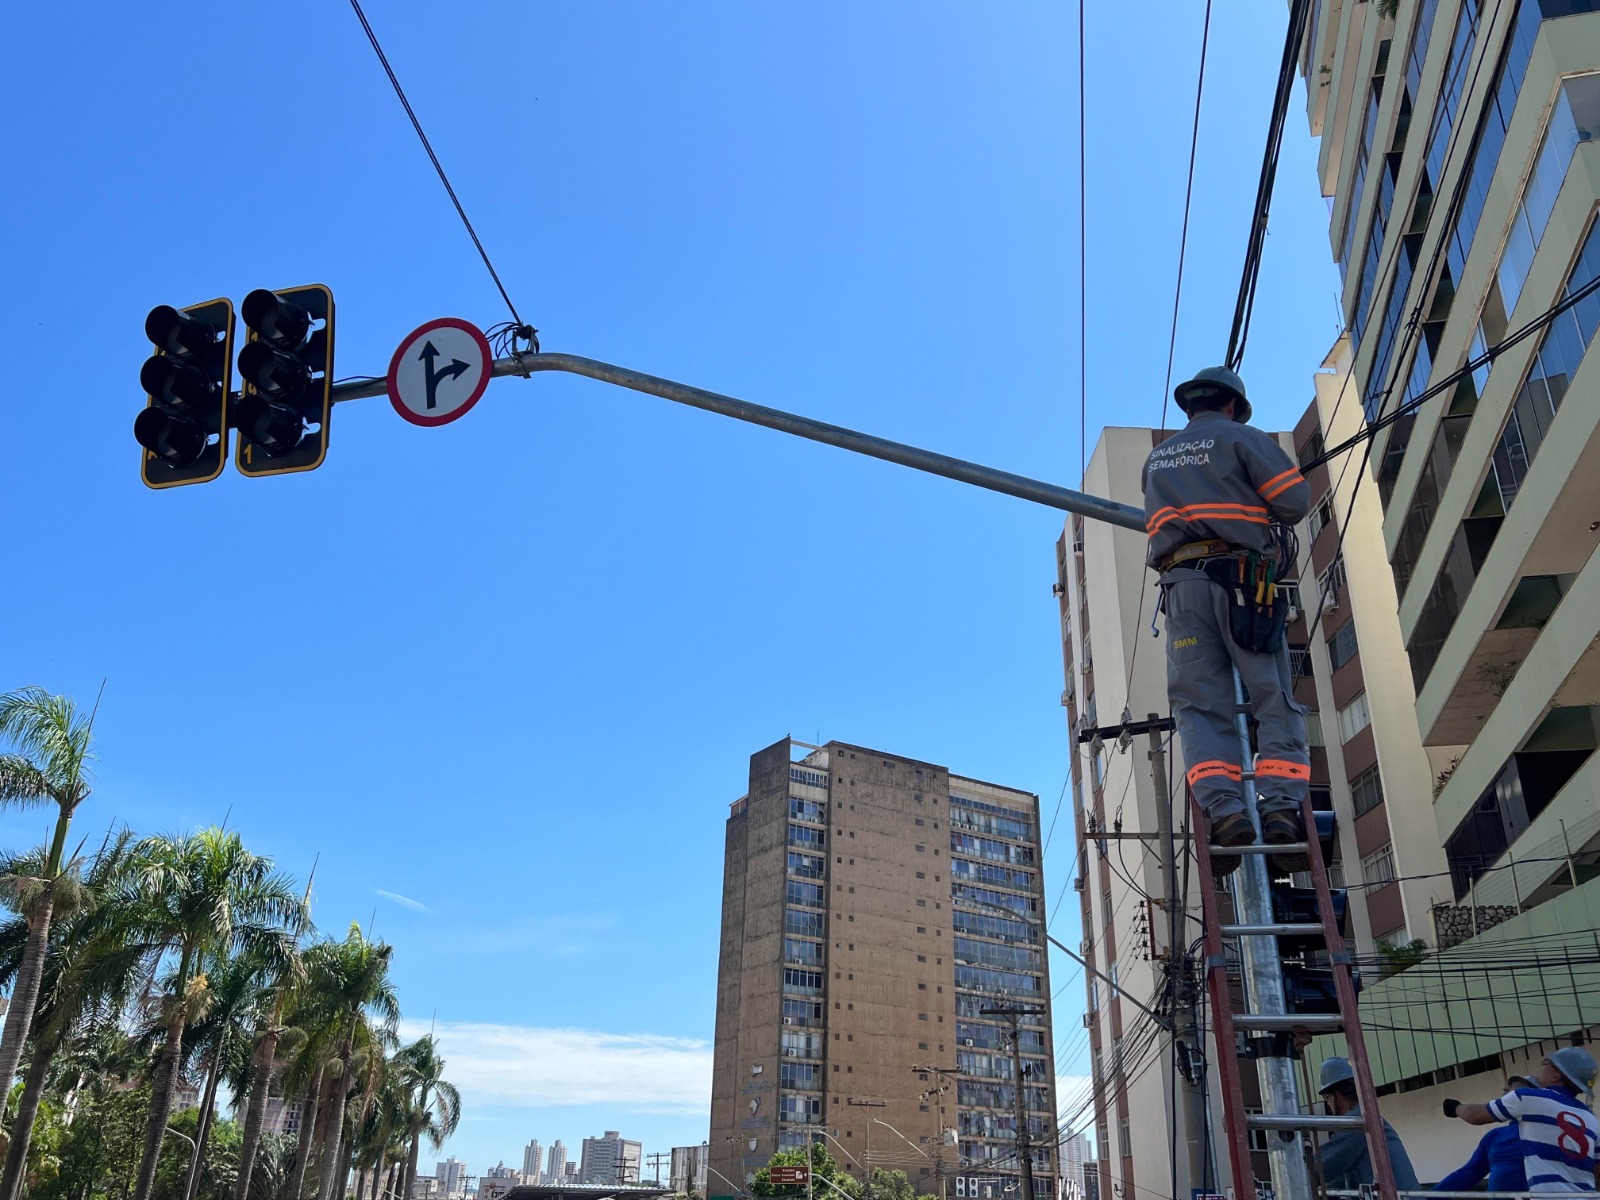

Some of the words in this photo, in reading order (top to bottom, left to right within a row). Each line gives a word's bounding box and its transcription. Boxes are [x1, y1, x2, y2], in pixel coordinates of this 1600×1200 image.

[1150, 438, 1215, 461] SINALIZAÇÃO
[1148, 453, 1210, 473] SEMAFÓRICA
[1173, 636, 1198, 649] SMM
[1556, 1111, 1590, 1160] 8
